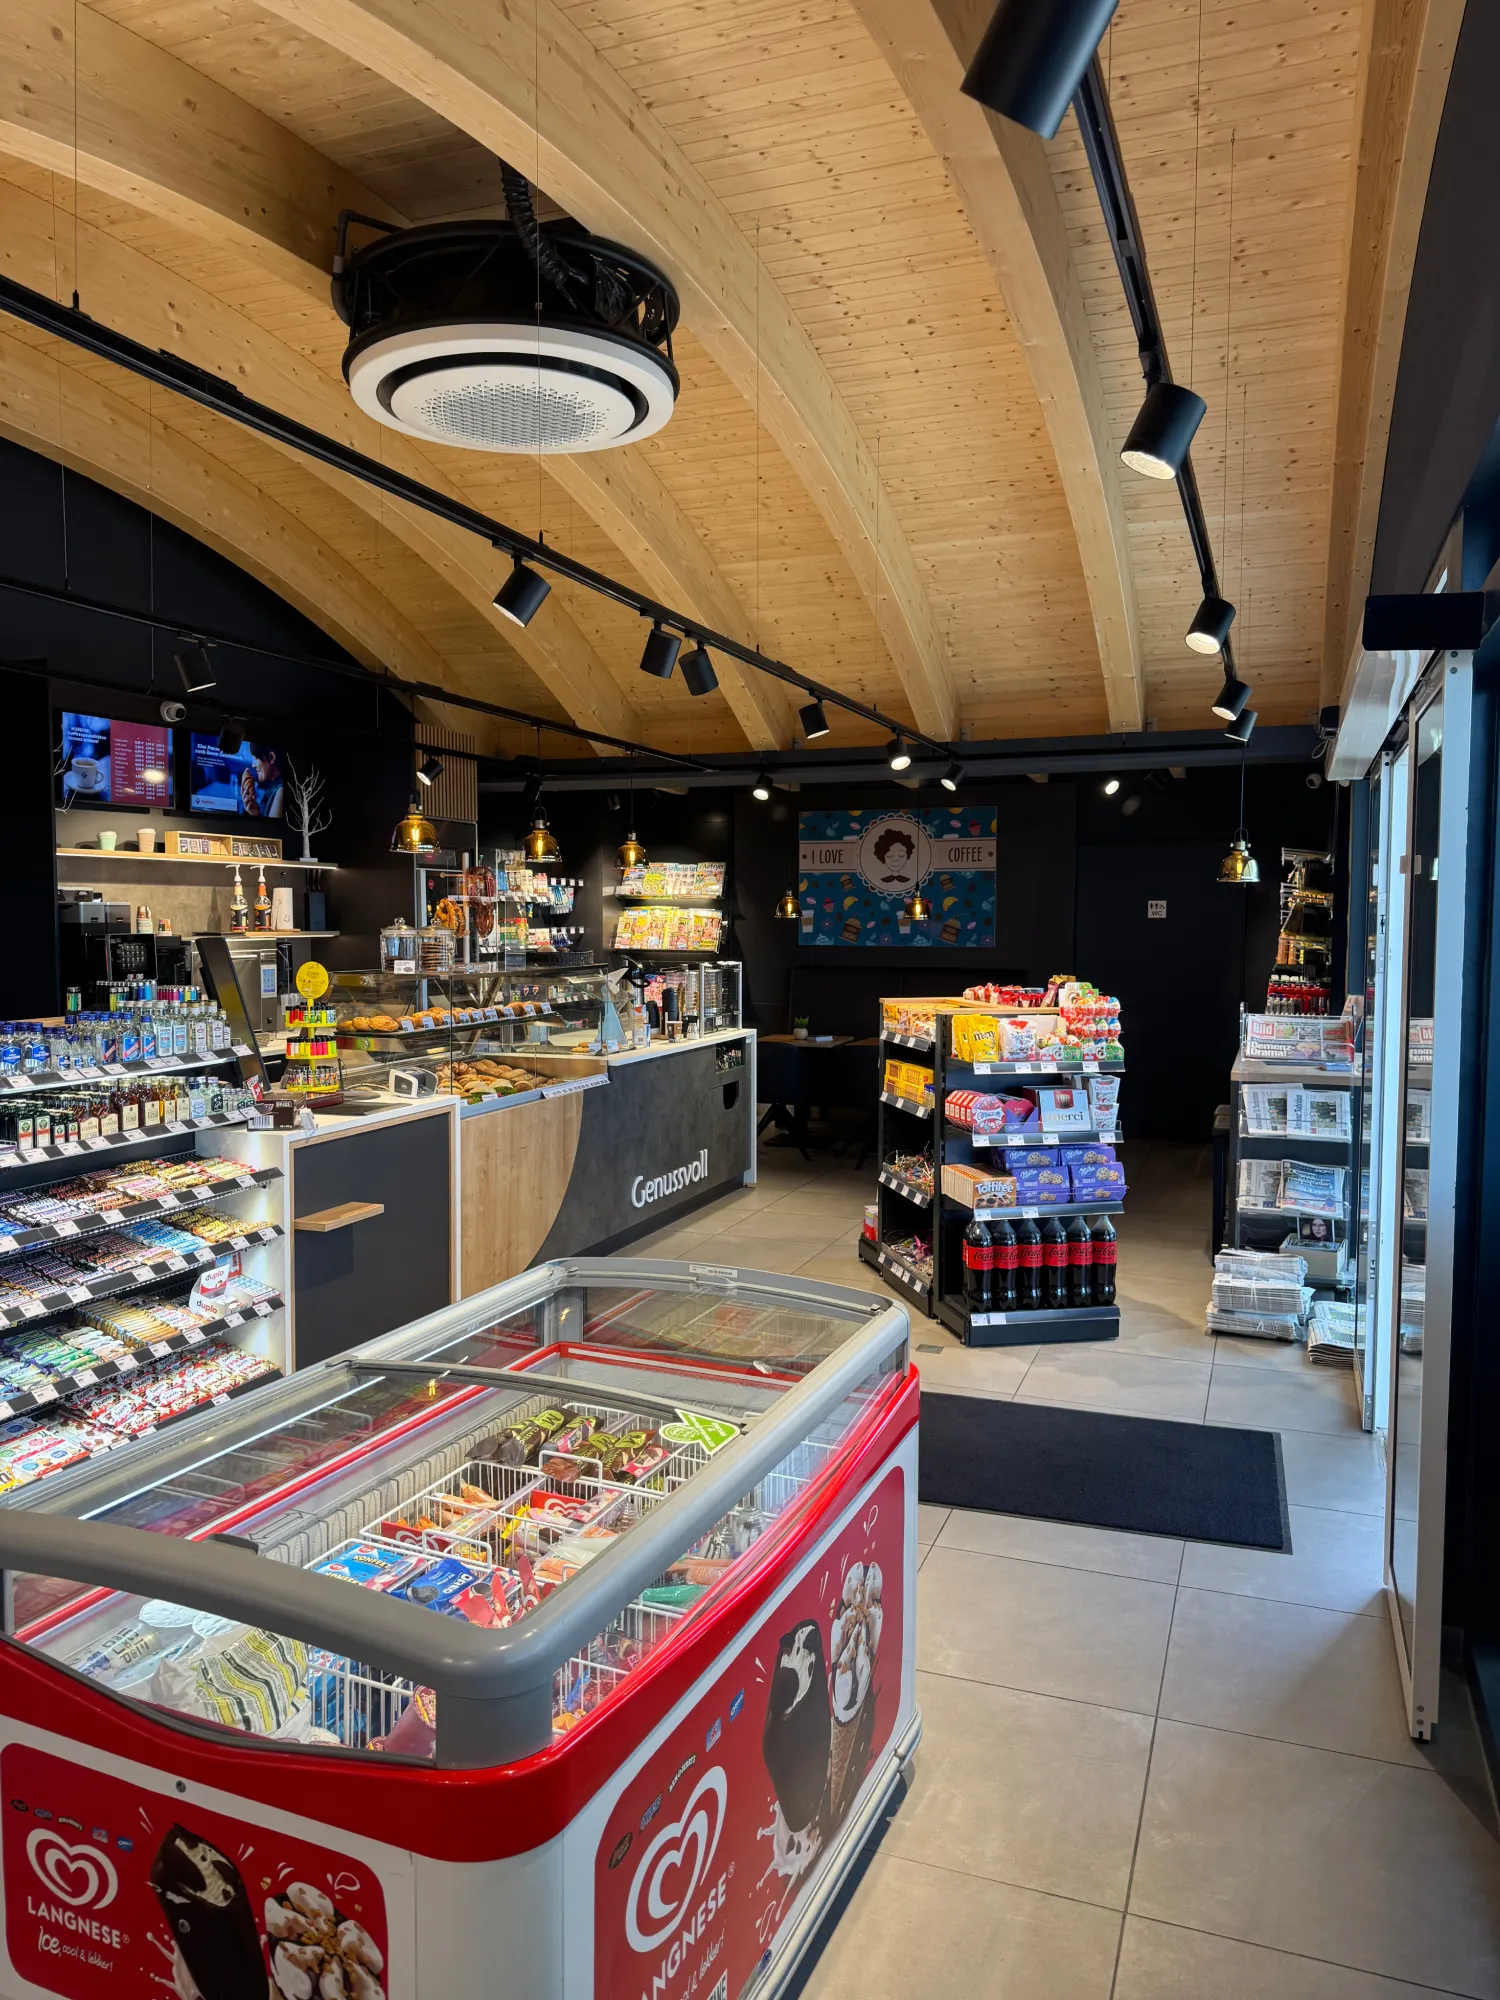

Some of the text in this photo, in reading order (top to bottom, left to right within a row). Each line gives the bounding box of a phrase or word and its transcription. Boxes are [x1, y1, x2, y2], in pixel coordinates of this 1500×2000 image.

[811, 846, 983, 864] I LOVE COFFEE
[1254, 1022, 1273, 1035] Bild
[1250, 1042, 1296, 1051] Demenz-
[1250, 1048, 1287, 1058] Drama!
[1047, 1110, 1084, 1122] merci
[1010, 1150, 1028, 1160] Milka
[1066, 1150, 1083, 1159] Milka
[1020, 1168, 1038, 1178] Milka
[1078, 1166, 1096, 1176] Milka
[631, 1148, 708, 1208] Genussvoll
[975, 1180, 1014, 1194] Toffifee
[205, 1270, 224, 1282] duplo
[196, 1300, 218, 1315] duplo
[134, 1376, 152, 1388] bueno
[76, 1388, 94, 1400] bueno
[94, 1394, 112, 1407] bueno
[352, 1555, 392, 1570] KONFEKT
[443, 1574, 473, 1594] OREO
[28, 1896, 121, 1949] LANGNESE
